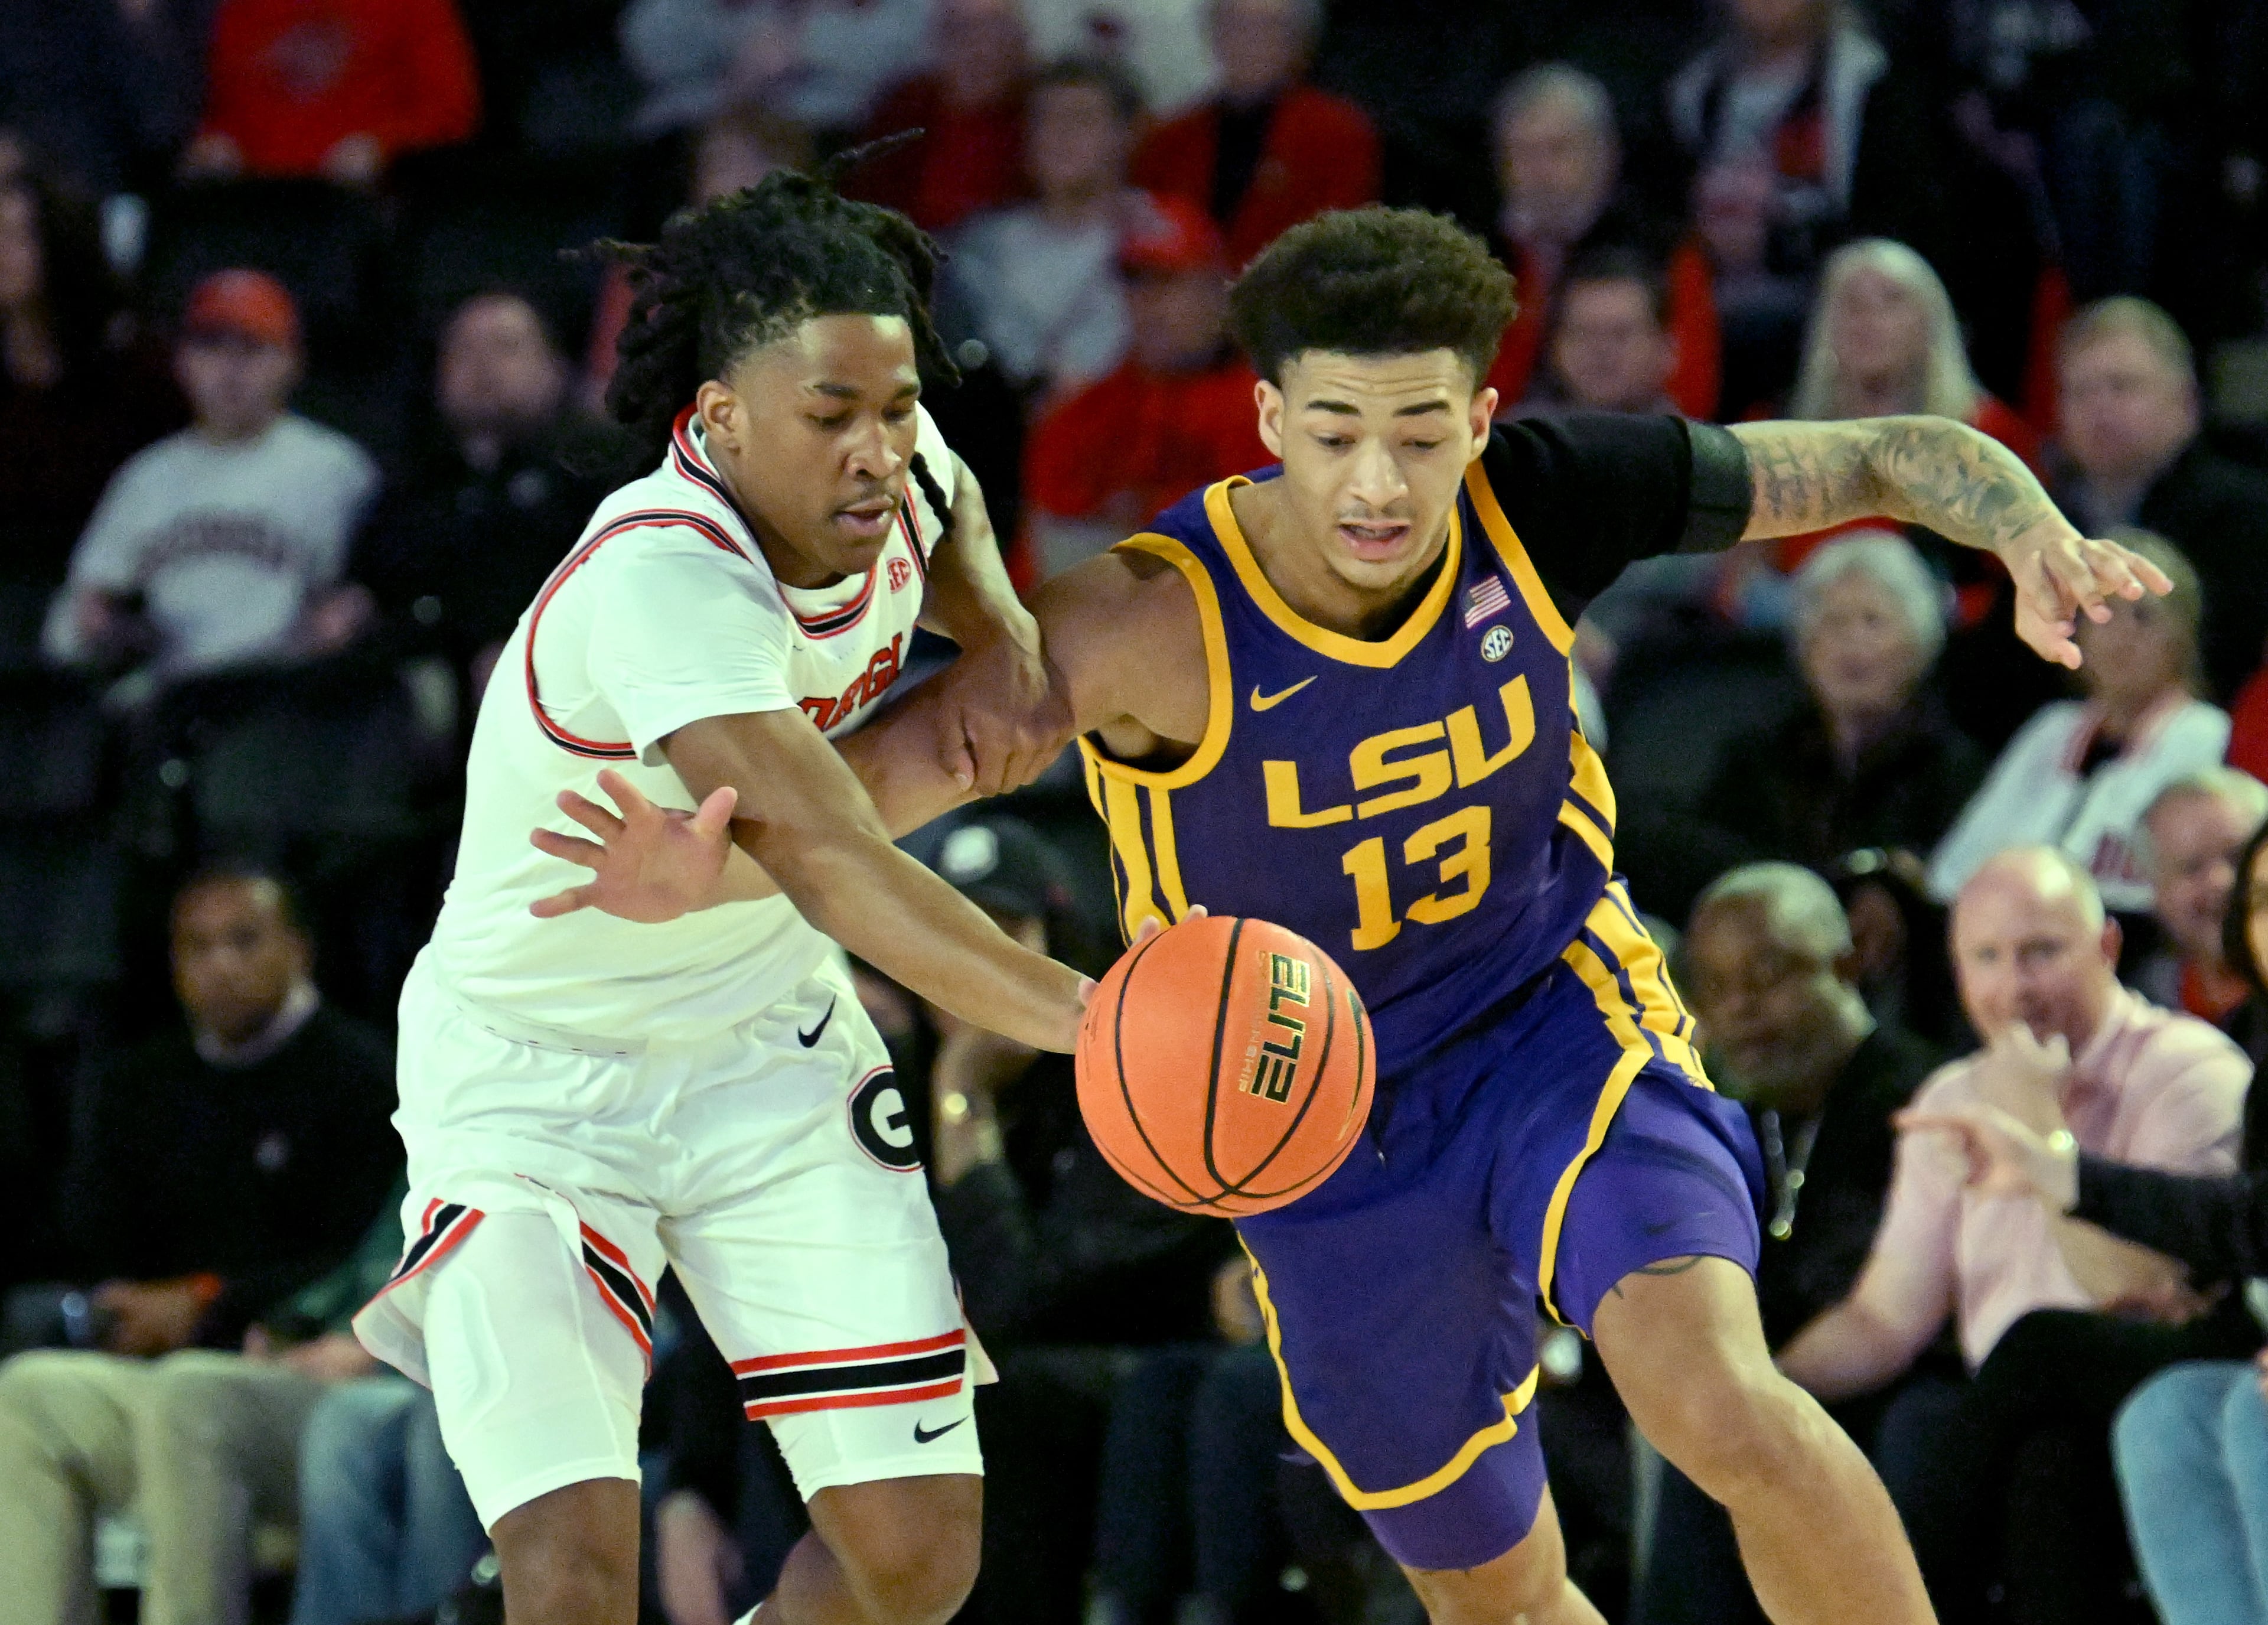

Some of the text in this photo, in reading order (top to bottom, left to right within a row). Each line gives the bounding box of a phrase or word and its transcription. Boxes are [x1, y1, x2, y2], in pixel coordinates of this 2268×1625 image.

[1484, 628, 1511, 659] SEC
[1262, 674, 1536, 828] LSU
[1342, 805, 1491, 950] 13
[1249, 952, 1311, 1105] ELITE
[849, 1070, 922, 1168] G
